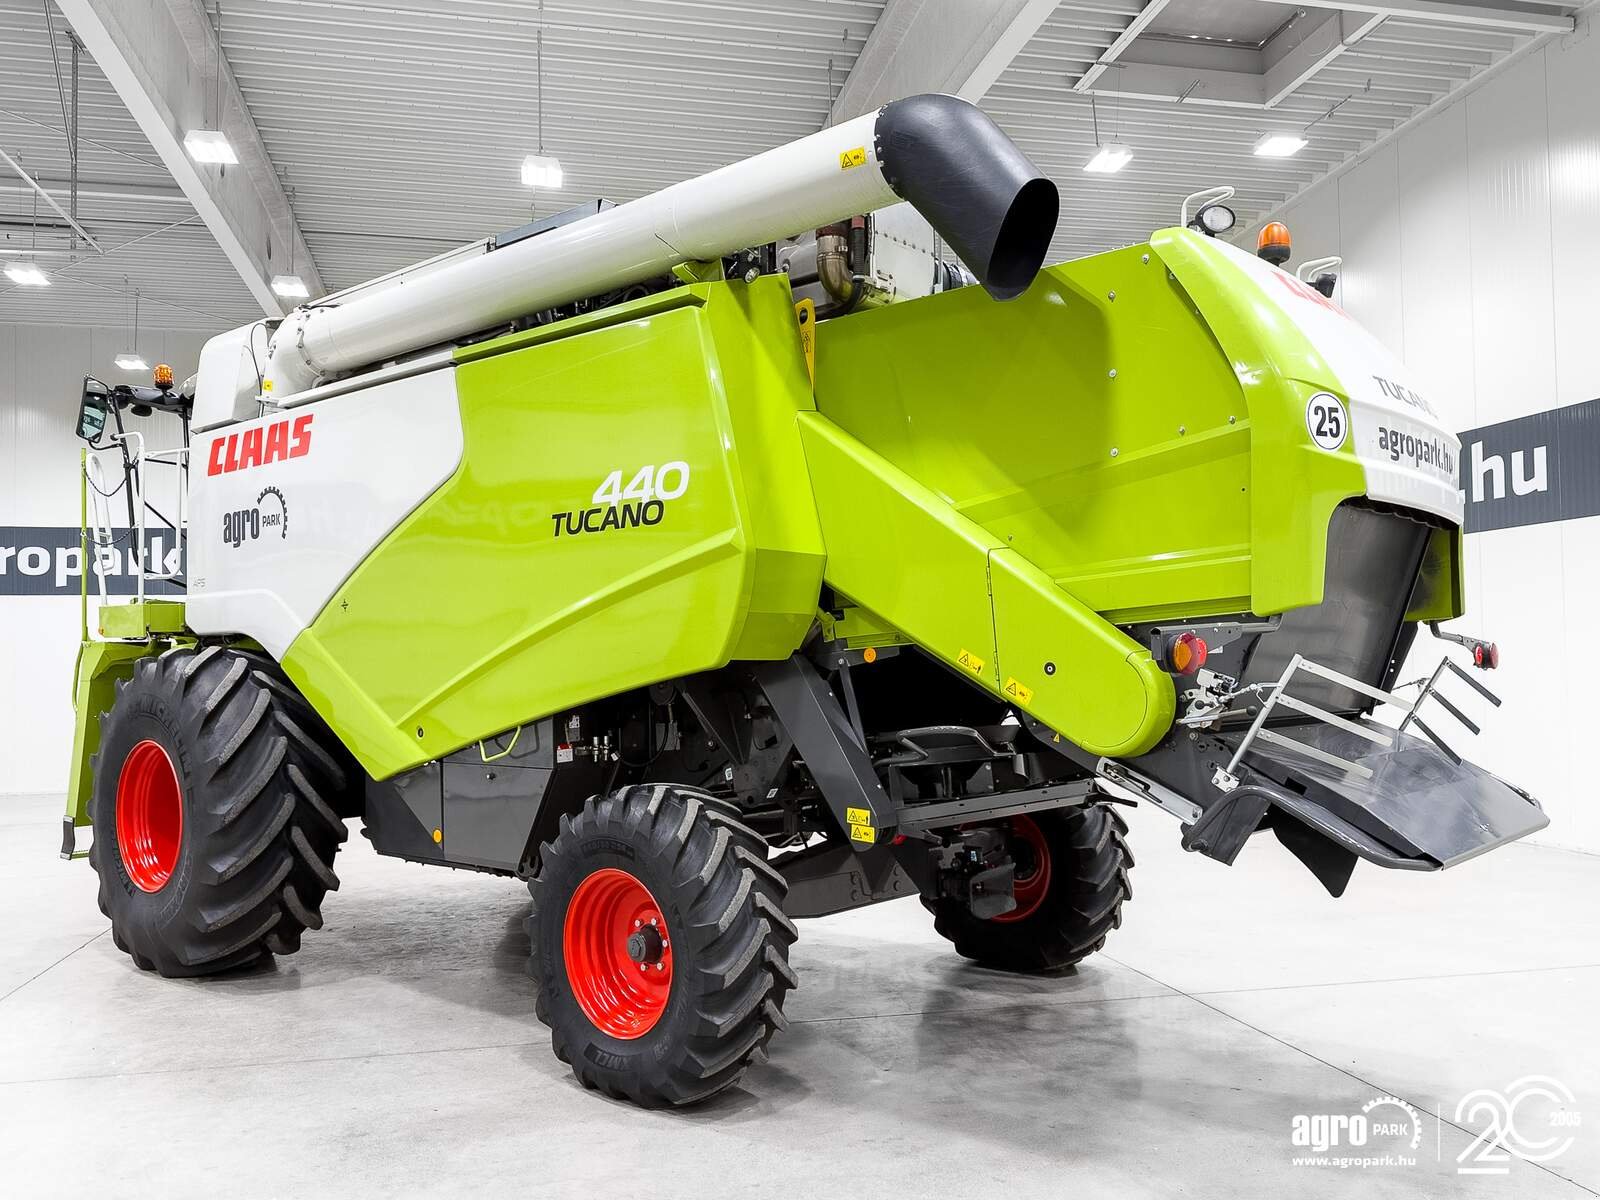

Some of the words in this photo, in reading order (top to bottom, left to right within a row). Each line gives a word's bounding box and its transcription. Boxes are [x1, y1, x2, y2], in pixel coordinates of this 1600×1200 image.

[1313, 405, 1341, 438] 25
[207, 414, 314, 477] CLAAS
[1378, 426, 1454, 475] agropark.hu
[592, 461, 690, 506] 440
[223, 508, 260, 548] agro
[262, 513, 281, 528] PARK
[552, 500, 665, 537] TUCANO
